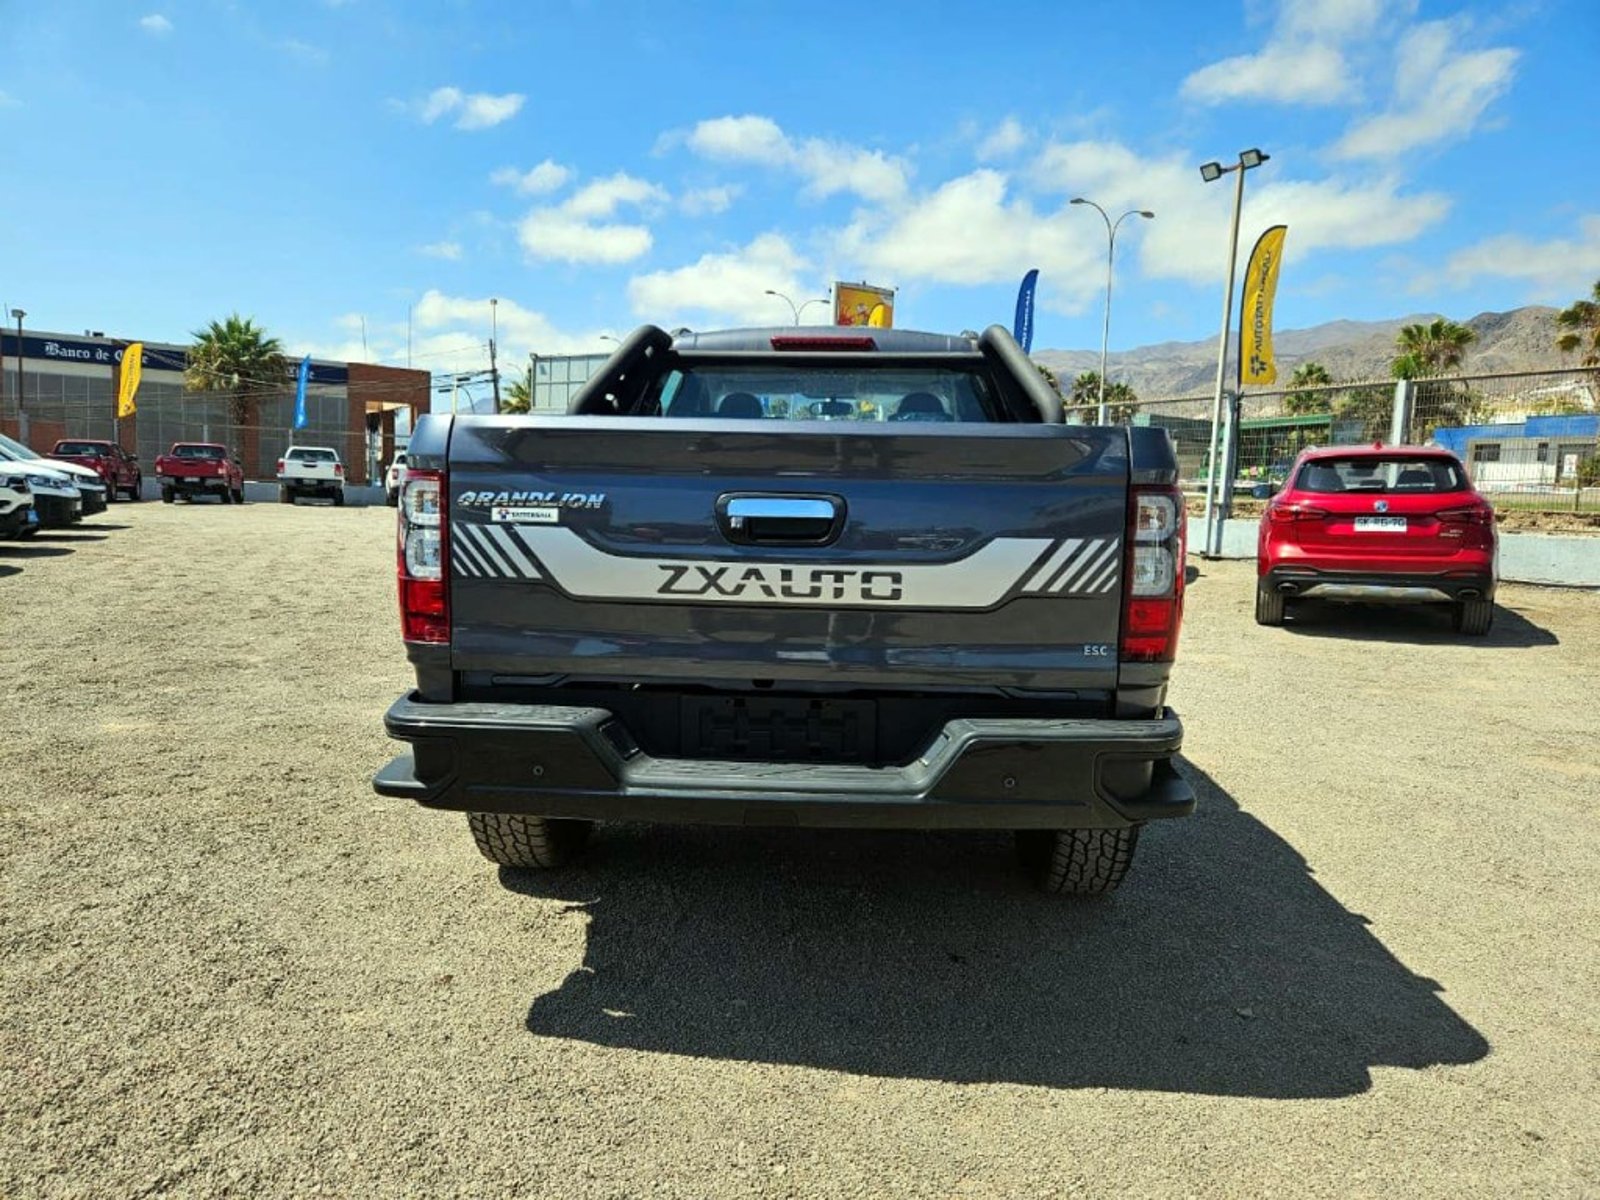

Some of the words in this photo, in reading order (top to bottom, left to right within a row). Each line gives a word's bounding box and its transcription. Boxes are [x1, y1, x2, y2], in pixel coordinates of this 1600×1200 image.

[44, 341, 90, 359] Banco
[95, 348, 110, 361] de
[657, 565, 902, 600] ZXAUTO
[1083, 645, 1107, 656] ESC
